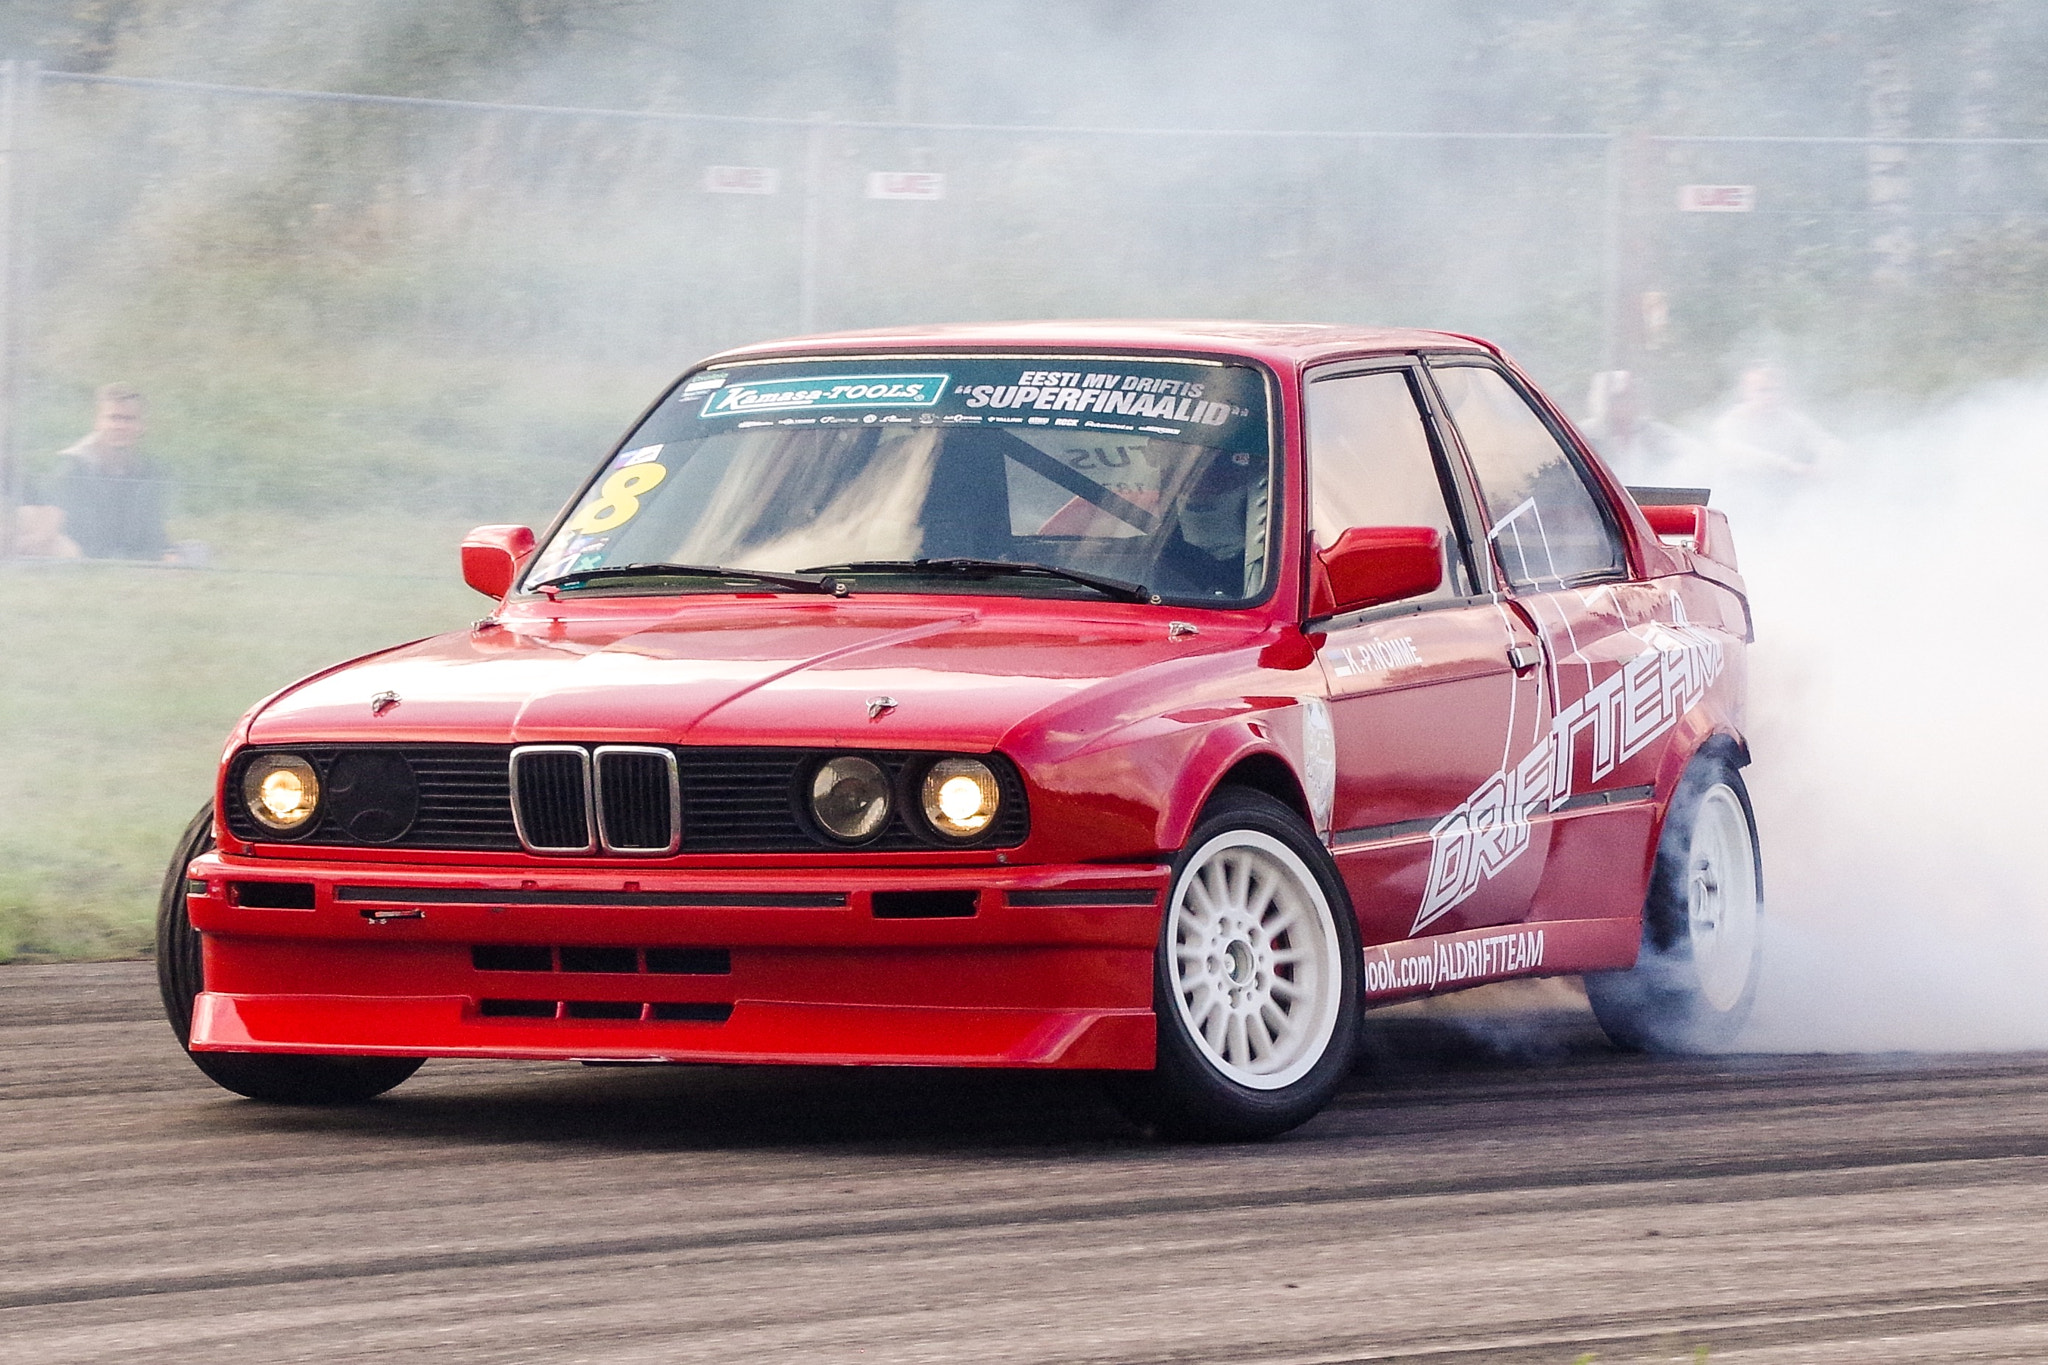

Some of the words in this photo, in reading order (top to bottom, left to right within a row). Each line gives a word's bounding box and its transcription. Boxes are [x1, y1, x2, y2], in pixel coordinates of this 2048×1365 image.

[716, 384, 924, 410] Kamasa-TOOLS
[1018, 371, 1081, 388] EESTI
[1081, 373, 1121, 390] MV
[1121, 376, 1205, 398] DRIFTIS
[568, 462, 668, 535] 8
